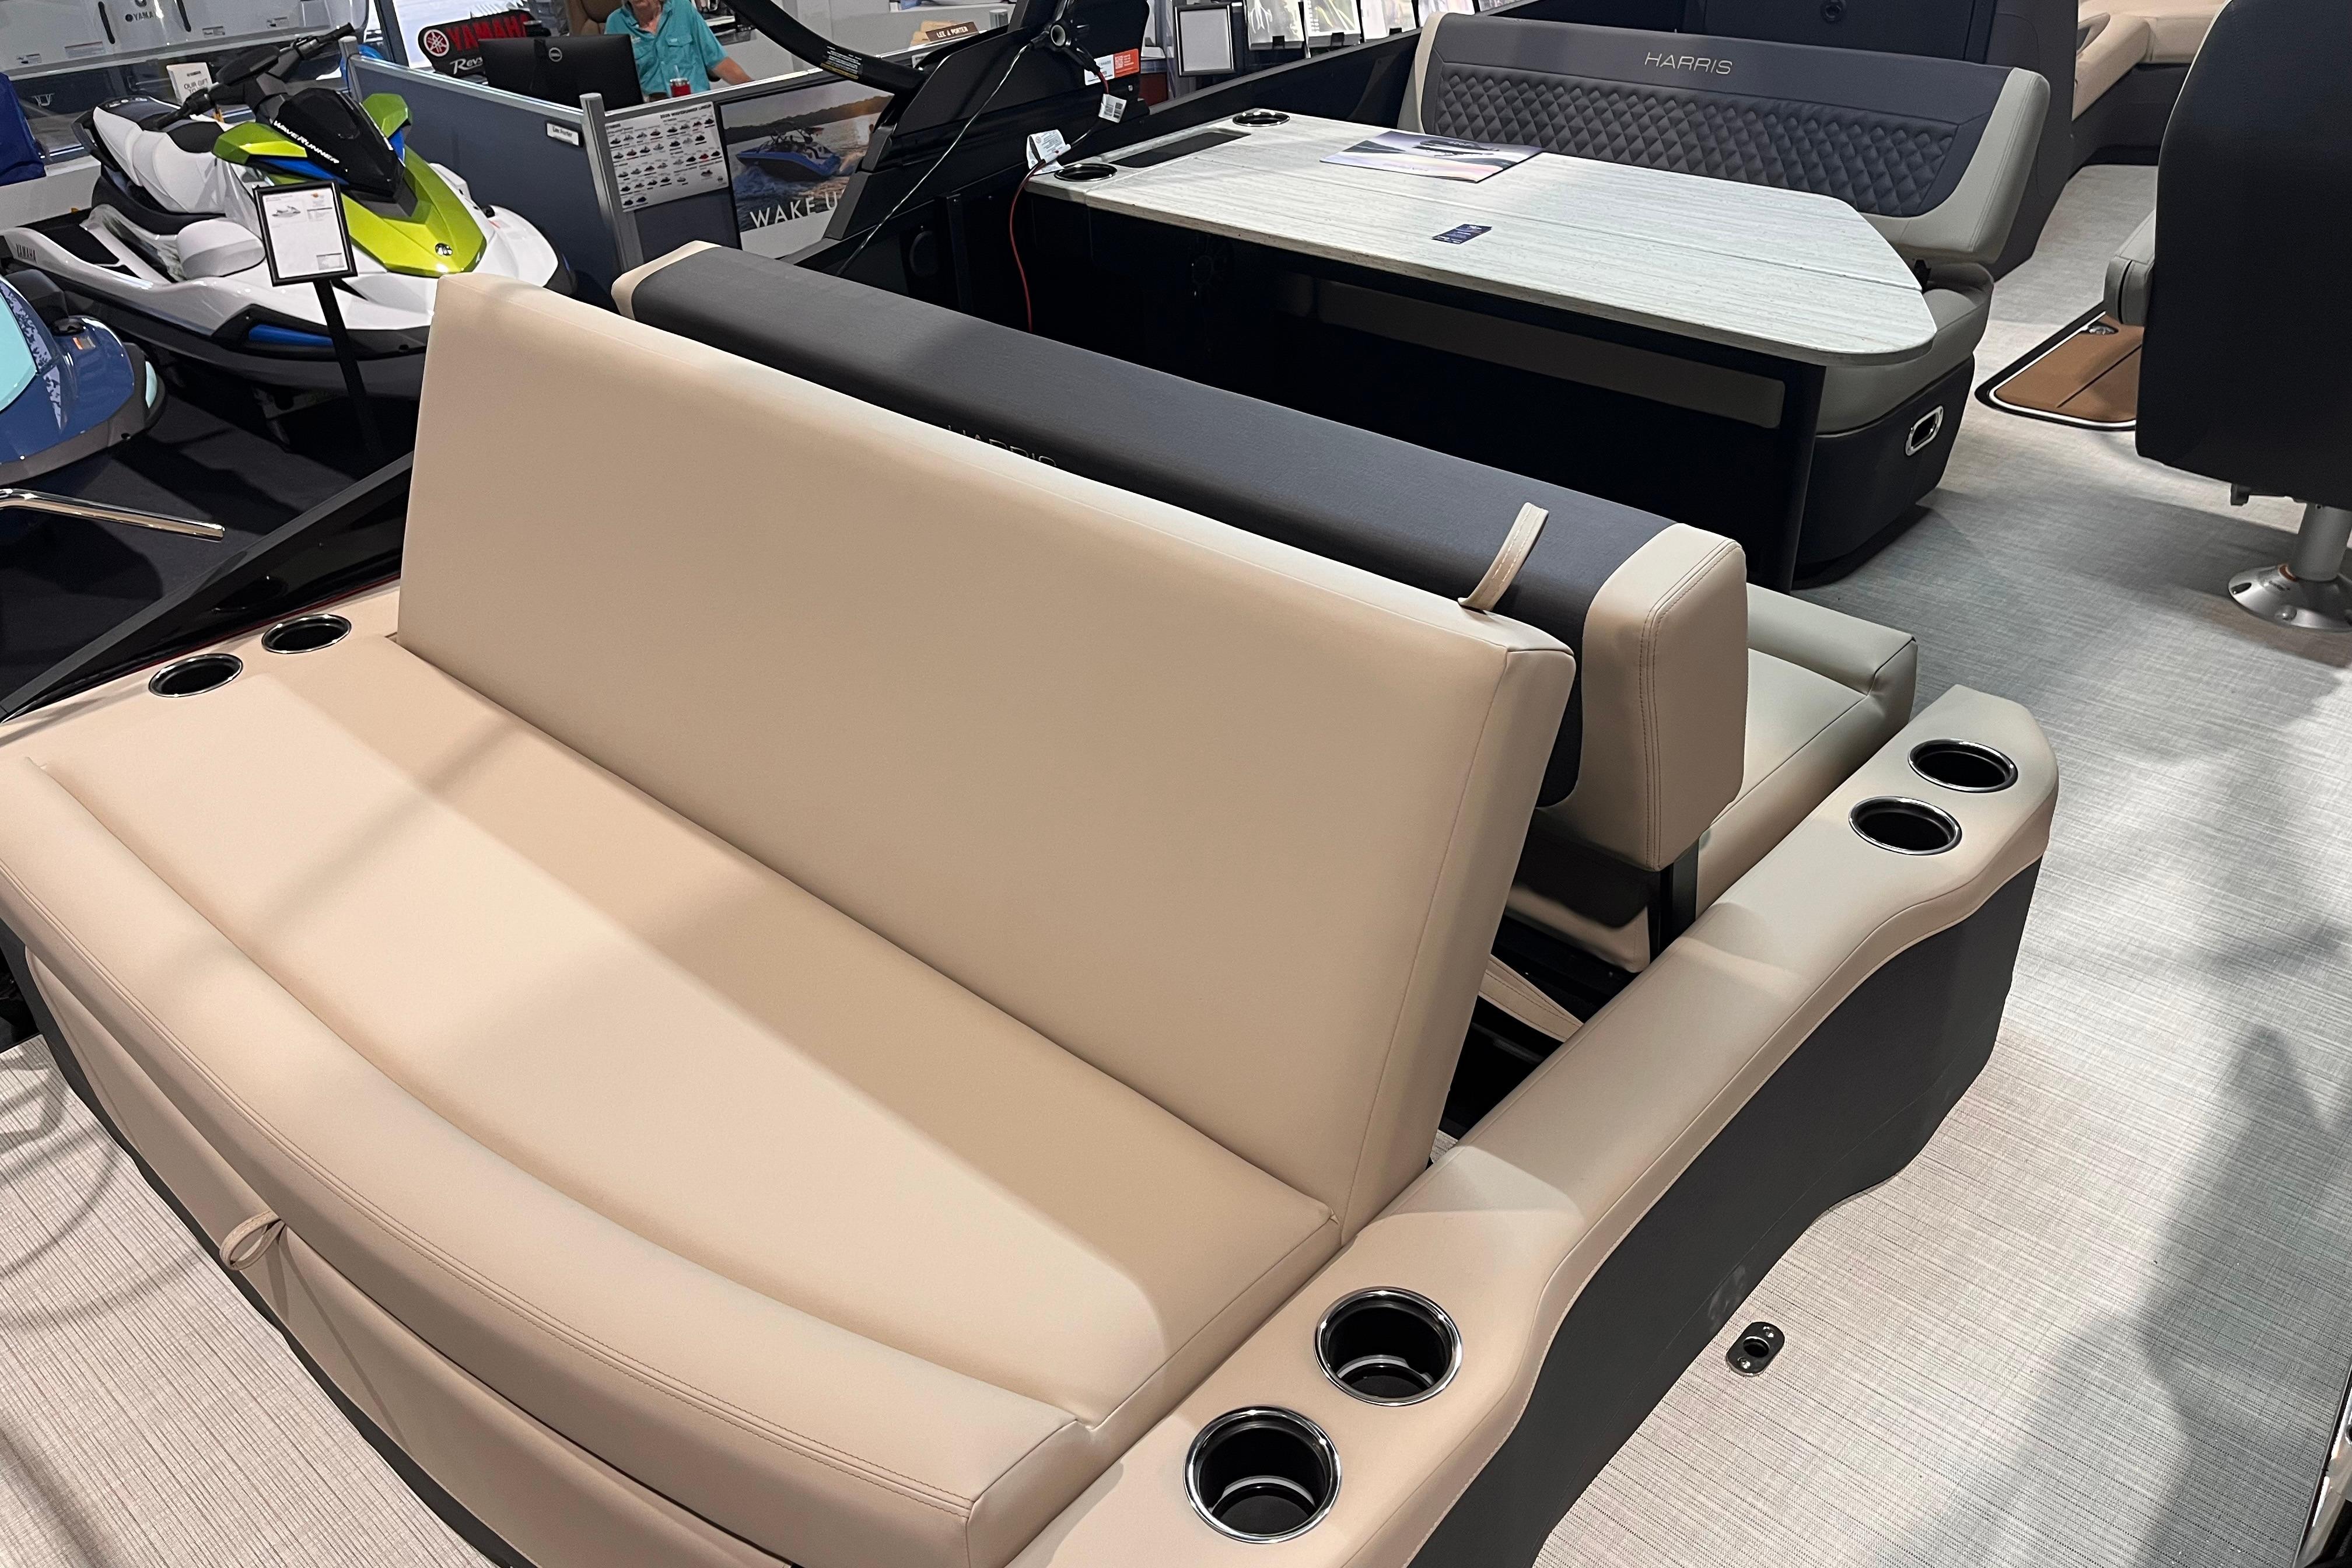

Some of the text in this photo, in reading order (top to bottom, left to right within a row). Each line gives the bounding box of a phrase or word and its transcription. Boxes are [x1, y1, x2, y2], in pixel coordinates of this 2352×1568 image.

[446, 11, 532, 52] YAMAHA
[950, 26, 969, 36] PORTER
[449, 56, 484, 75] Revs
[1644, 51, 1732, 75] HARRIS
[749, 196, 816, 228] WAKE
